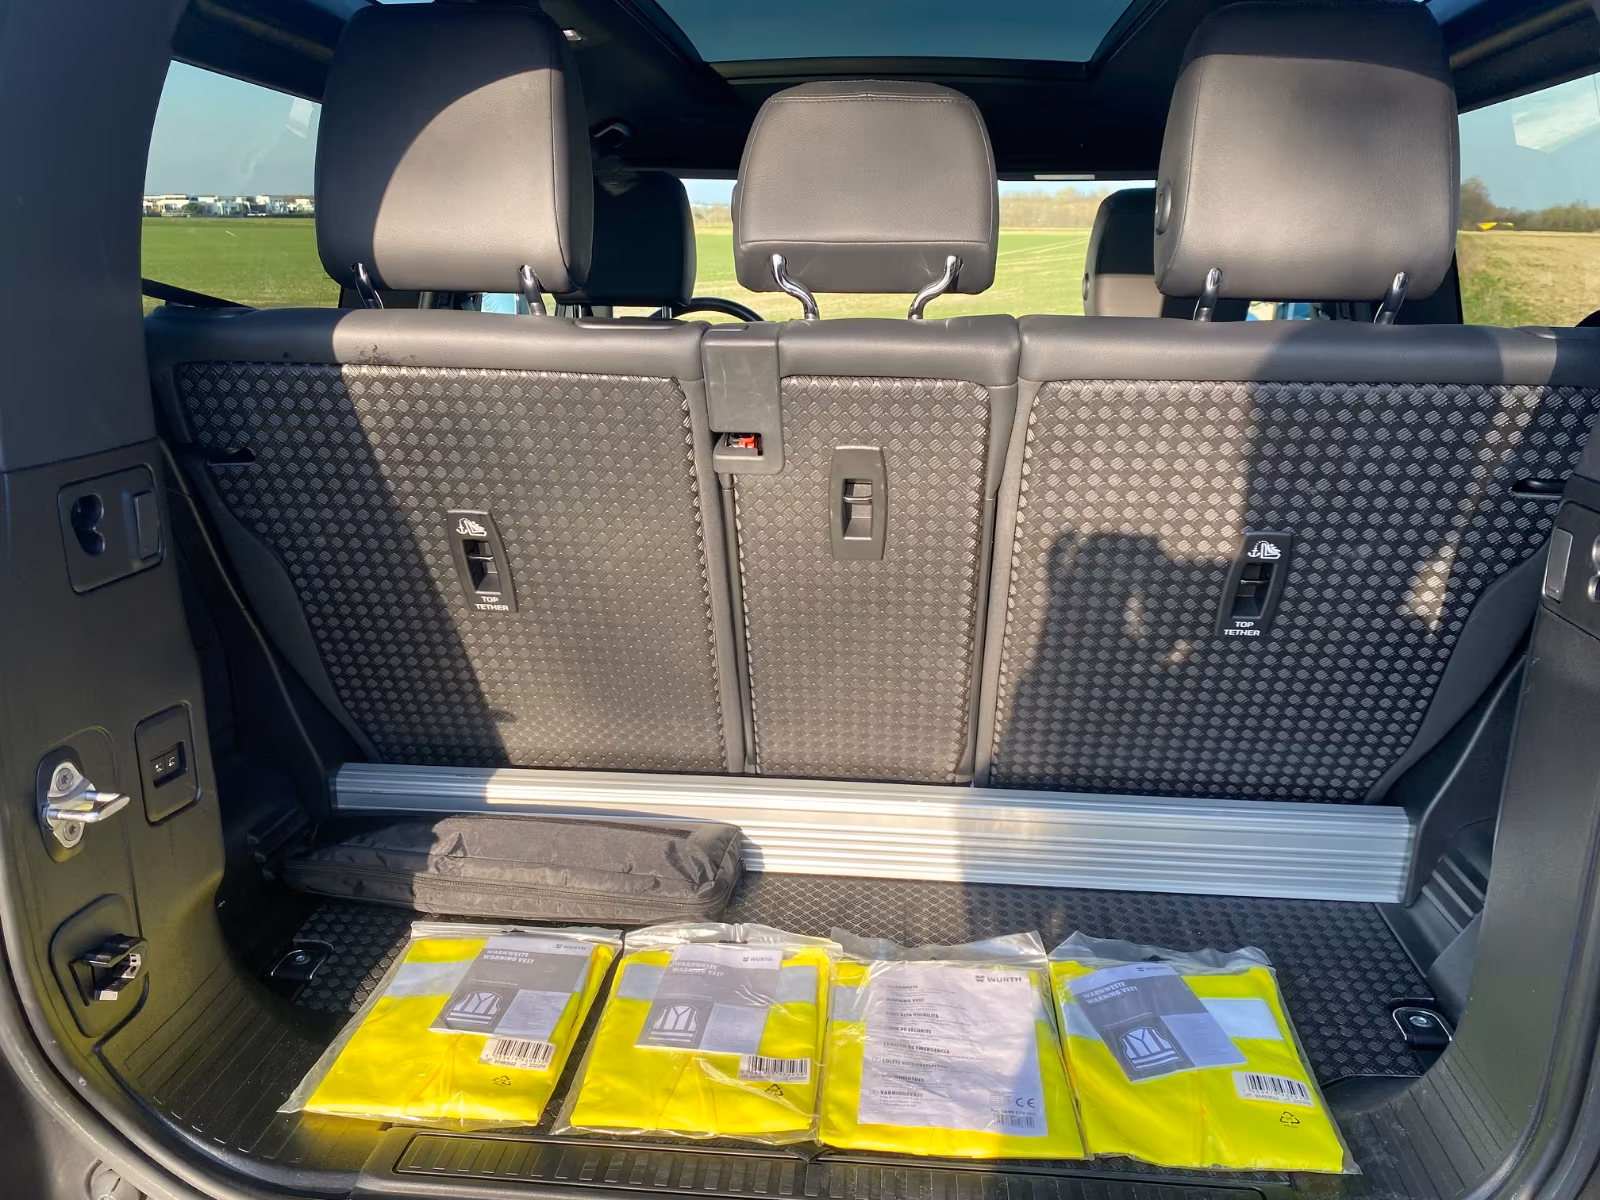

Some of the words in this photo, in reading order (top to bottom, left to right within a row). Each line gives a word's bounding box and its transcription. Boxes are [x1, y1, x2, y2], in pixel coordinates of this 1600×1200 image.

[483, 954, 516, 962] WARNING
[487, 950, 529, 958] WARNWESTE
[674, 961, 719, 970] WARNWESTE
[708, 969, 724, 977] VEST
[1082, 981, 1127, 999] WARNWESTE
[1086, 990, 1121, 1004] WARNING
[1015, 1097, 1036, 1108] CE
